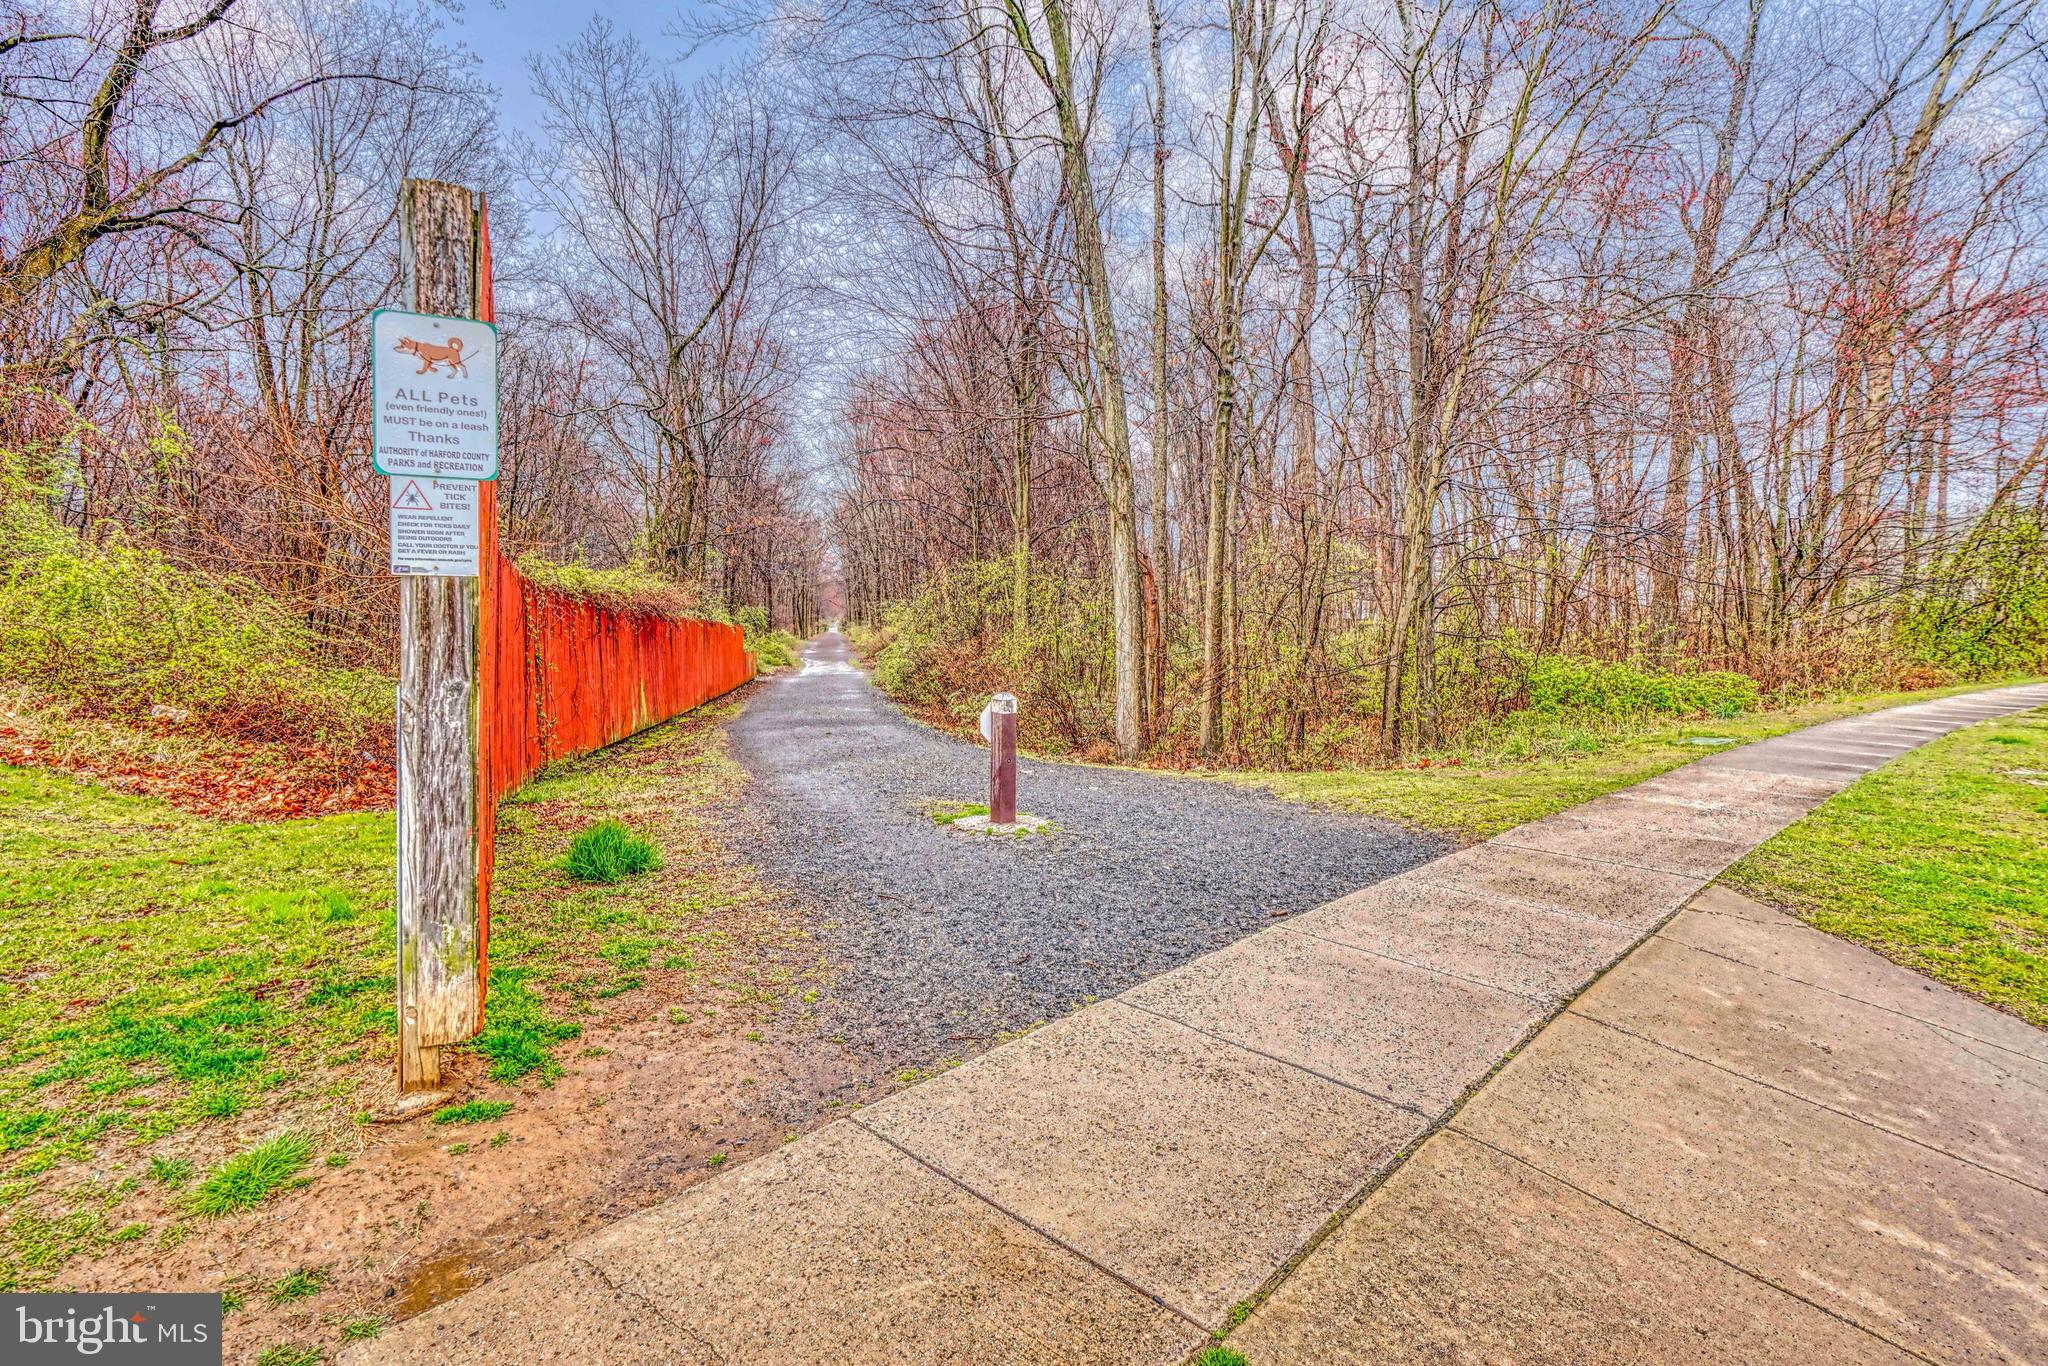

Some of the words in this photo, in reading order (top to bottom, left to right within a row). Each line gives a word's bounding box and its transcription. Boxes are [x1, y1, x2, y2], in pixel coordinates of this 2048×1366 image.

[395, 388, 431, 402] ALL
[439, 392, 478, 406] Pets
[386, 402, 414, 411] (even
[416, 404, 454, 416] friendly
[457, 409, 487, 418] ones!)
[384, 416, 416, 425] MUST
[420, 418, 433, 428] be
[461, 422, 489, 432] leash
[408, 431, 460, 445] Thanks
[379, 446, 419, 457] AUTHORITY
[429, 450, 461, 460] HARFORD
[462, 453, 490, 461] COUNTY
[388, 458, 415, 467] PARKS
[434, 462, 483, 472] RECREATION
[433, 483, 477, 491] PREVENT
